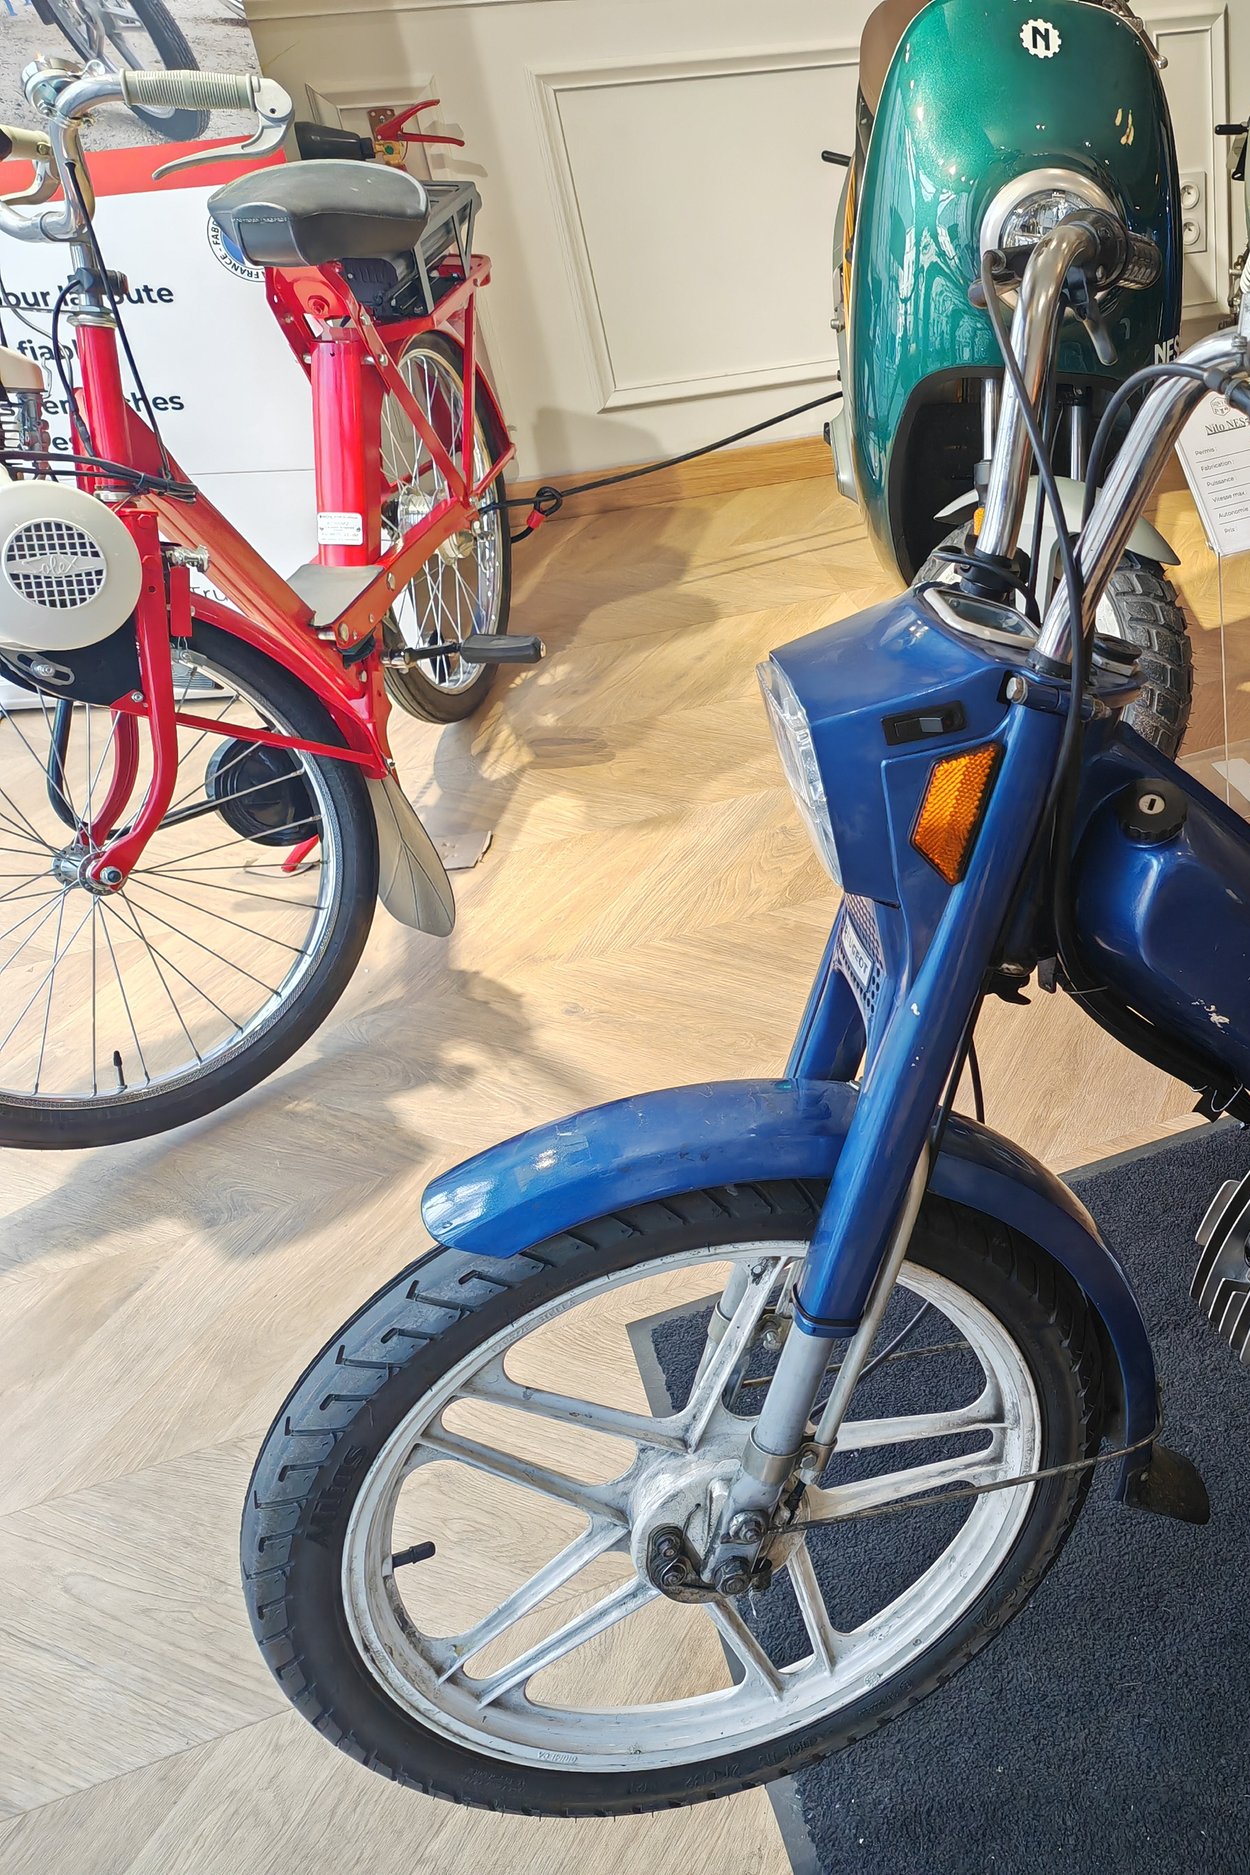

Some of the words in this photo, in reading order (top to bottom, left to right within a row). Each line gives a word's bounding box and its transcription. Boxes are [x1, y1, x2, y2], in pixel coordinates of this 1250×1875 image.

[1031, 25, 1051, 52] N
[219, 252, 260, 279] FRANCE
[1204, 423, 1226, 435] Nito
[1200, 460, 1233, 472] Fabrication
[1206, 476, 1235, 487] Puissance
[1218, 506, 1249, 519] Autonomie
